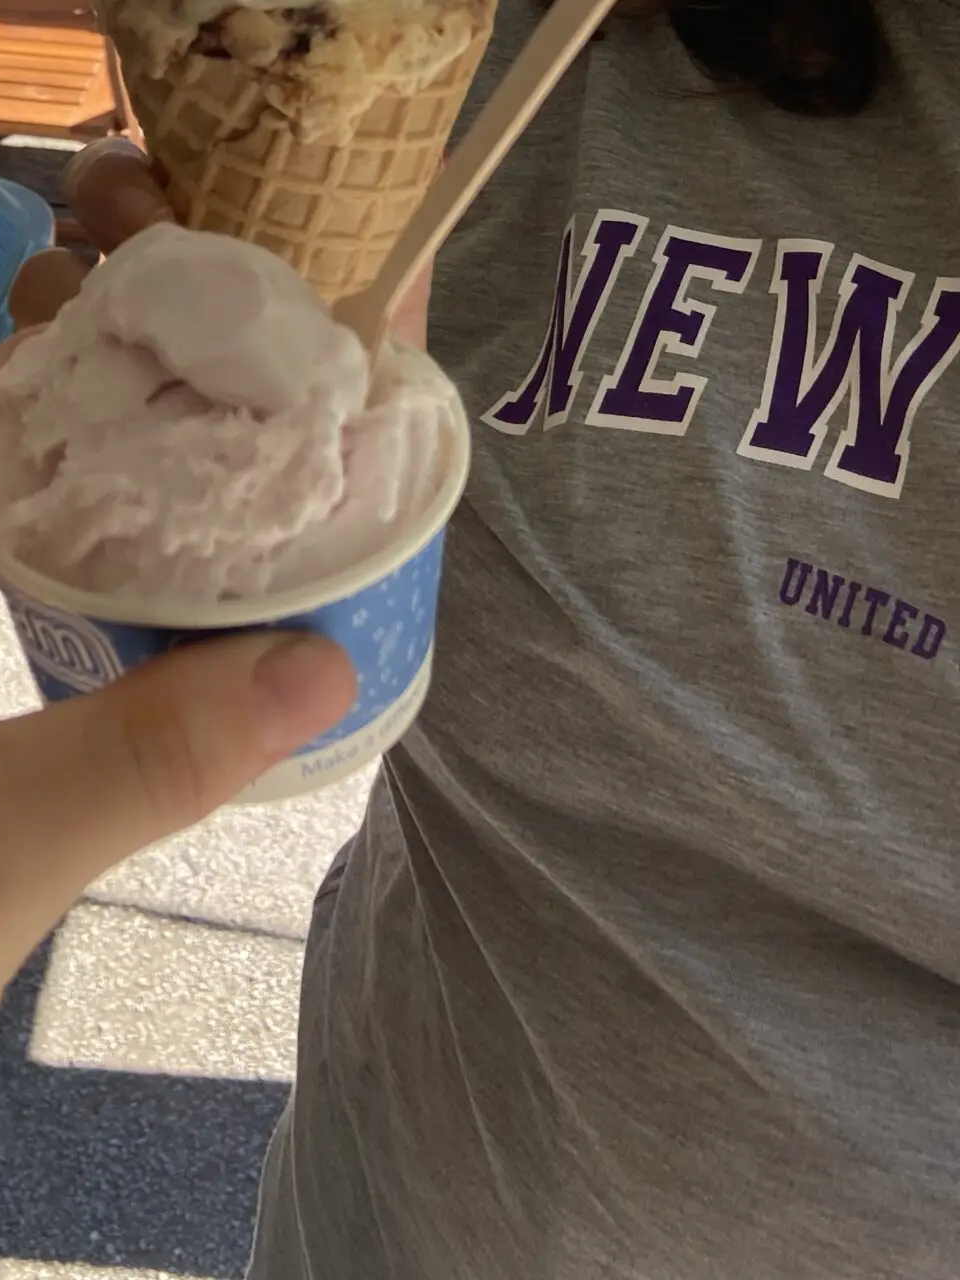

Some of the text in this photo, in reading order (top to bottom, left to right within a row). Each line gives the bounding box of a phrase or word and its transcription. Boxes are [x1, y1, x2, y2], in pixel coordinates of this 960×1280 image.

[480, 208, 960, 499] NEW
[779, 557, 947, 660] UNITED
[300, 743, 359, 778] Make
